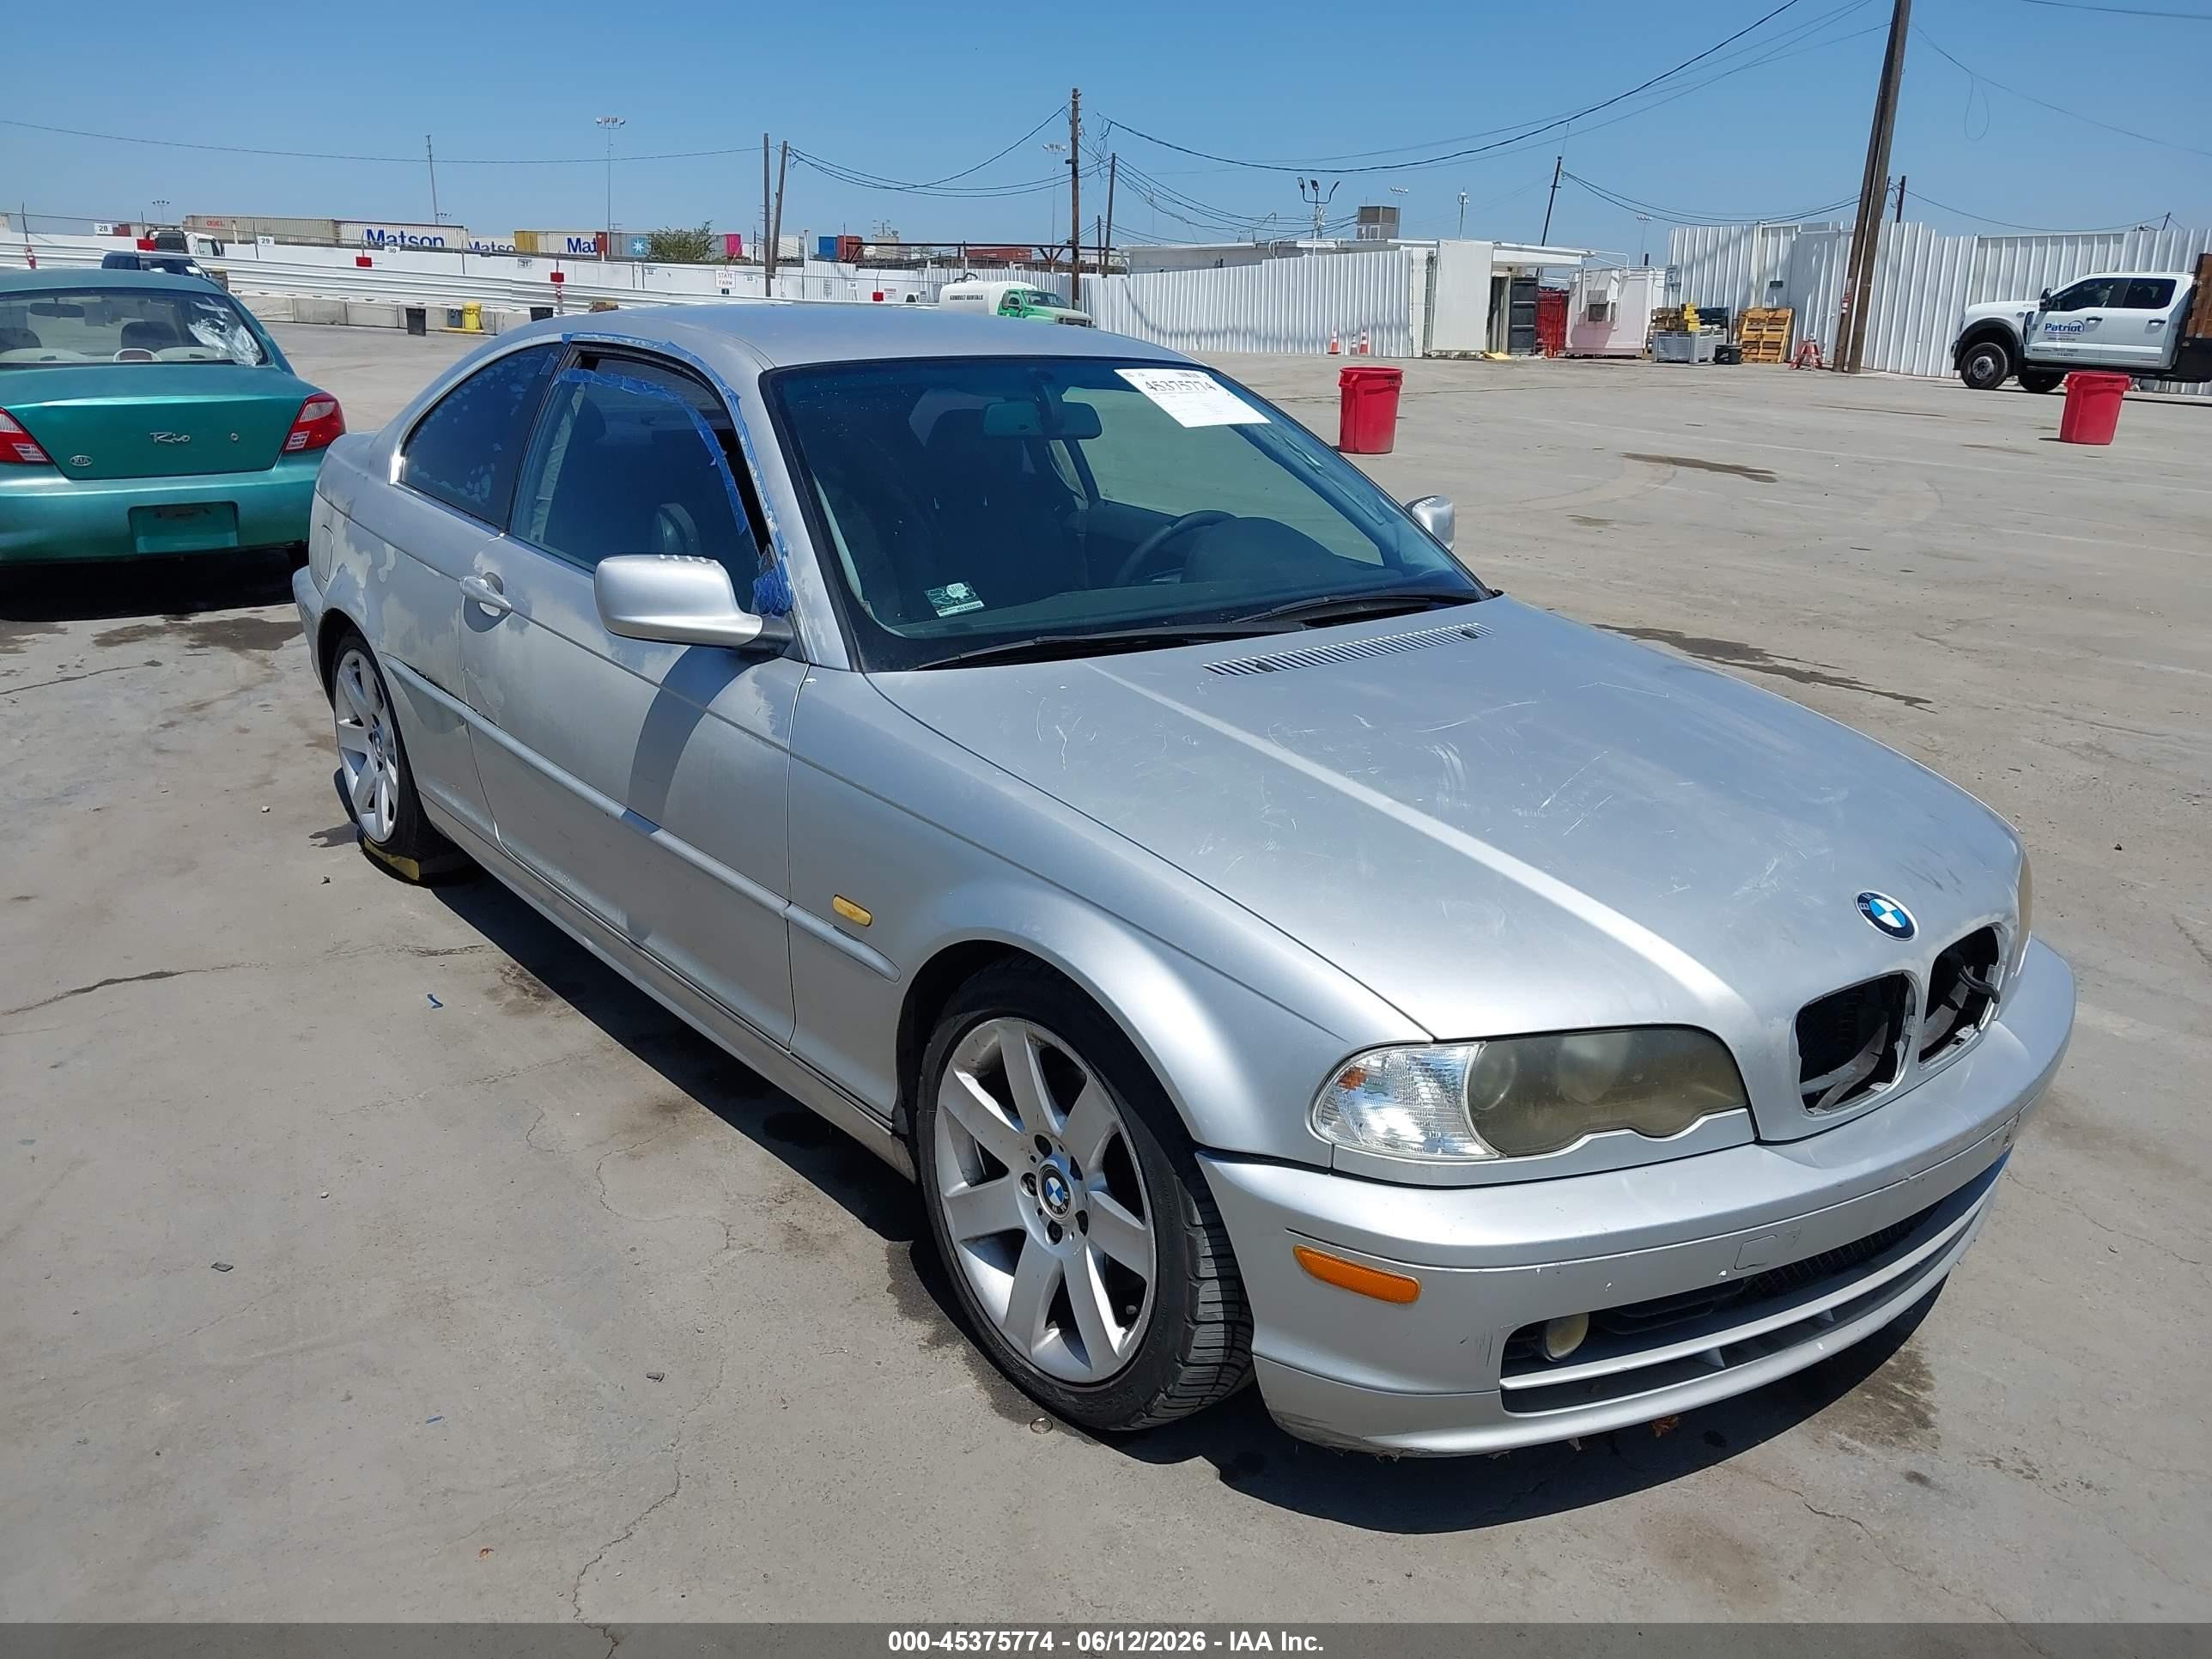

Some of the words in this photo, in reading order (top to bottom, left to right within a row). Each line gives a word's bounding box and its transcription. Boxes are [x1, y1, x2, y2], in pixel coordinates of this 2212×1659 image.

[366, 228, 445, 247] Matson
[2044, 322, 2083, 332] Patriot
[1145, 380, 1218, 392] 45375774
[149, 431, 191, 444] Rio
